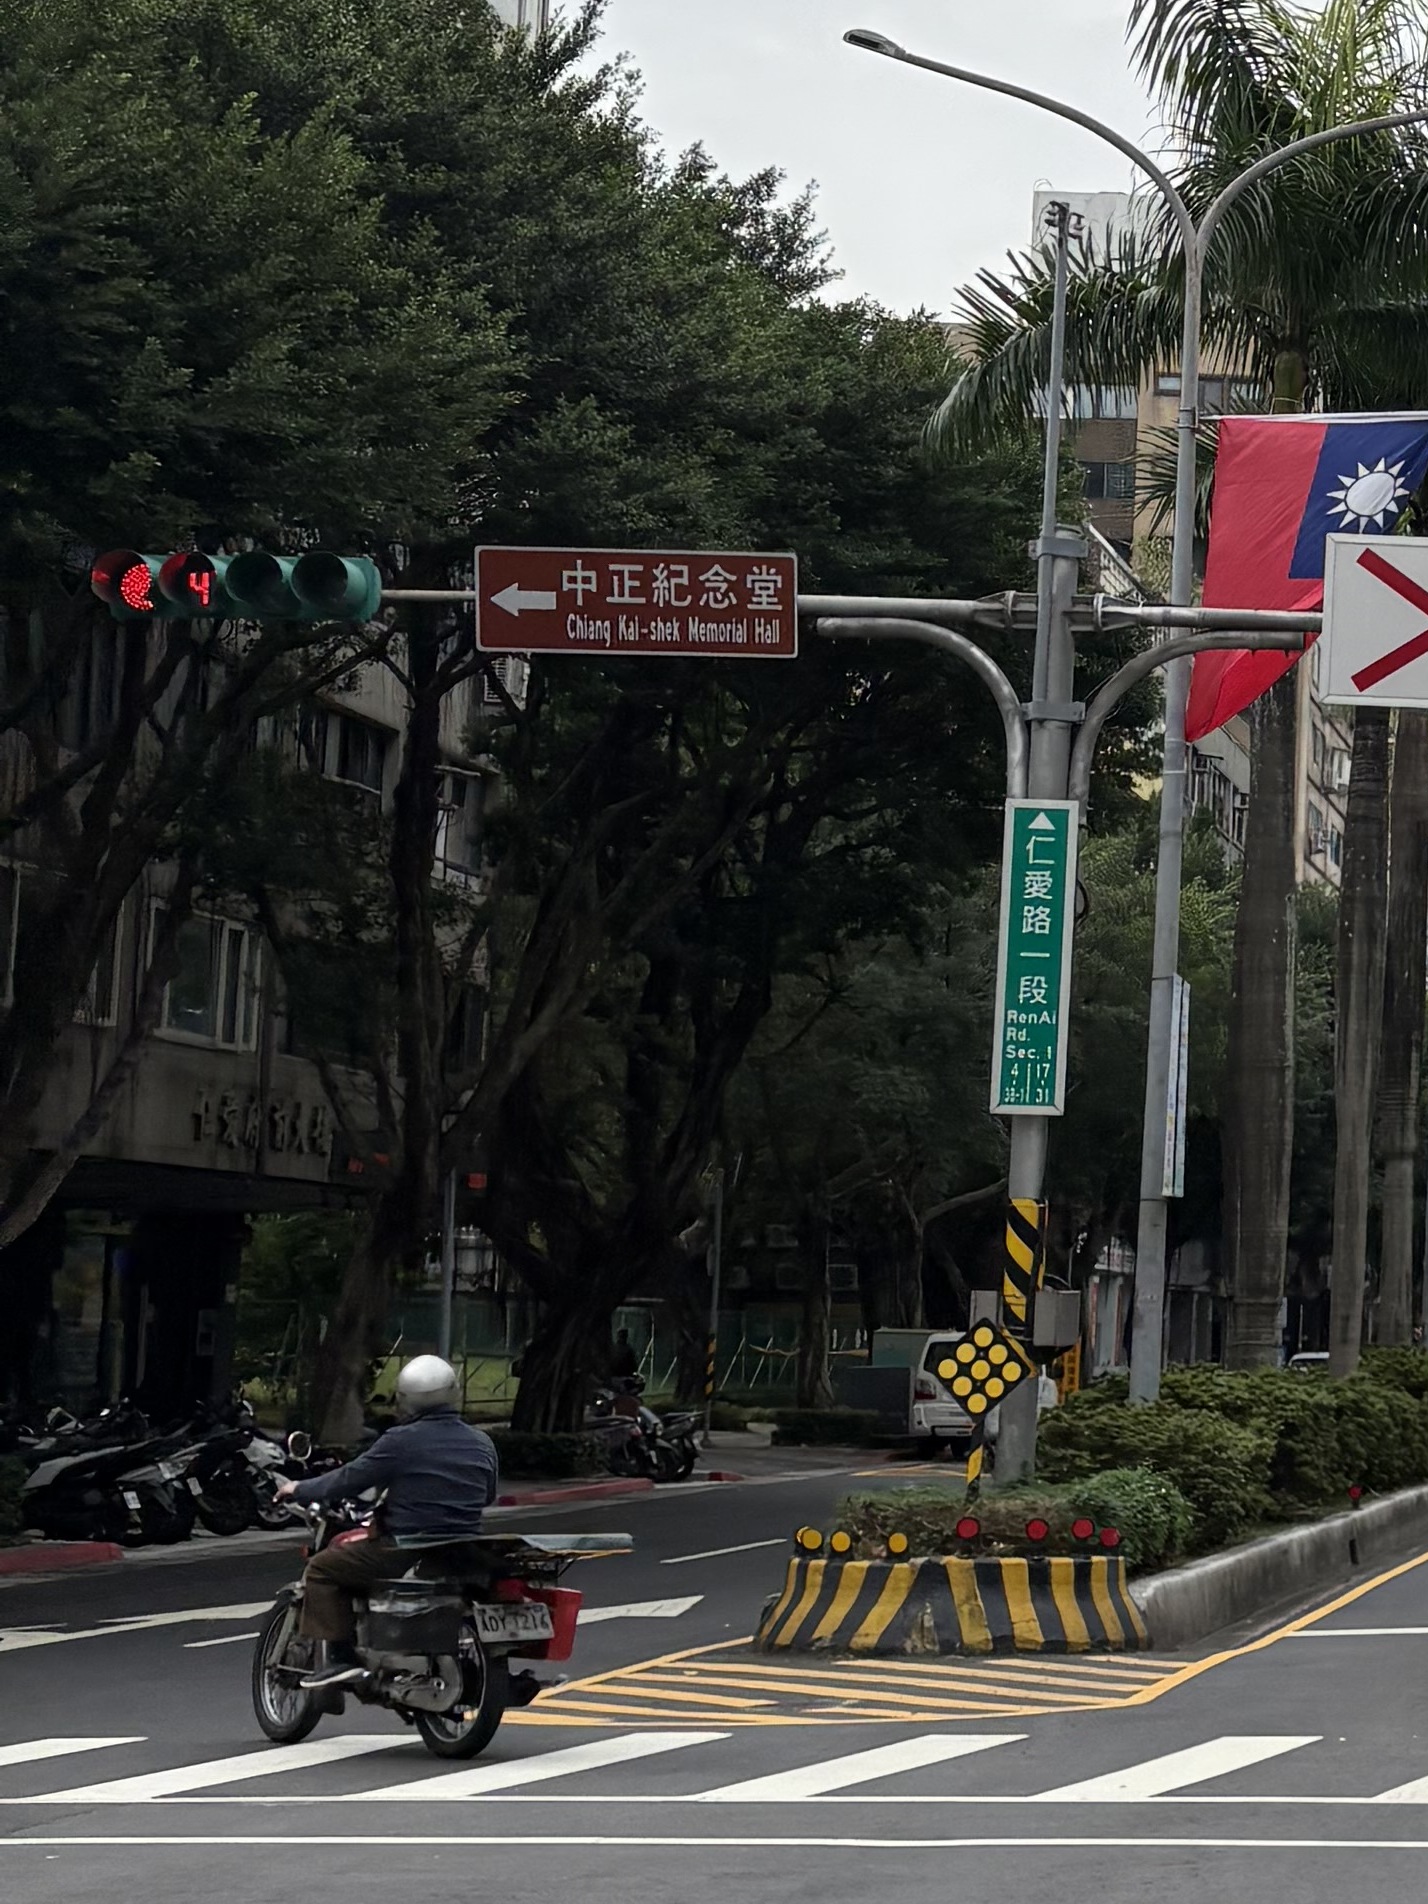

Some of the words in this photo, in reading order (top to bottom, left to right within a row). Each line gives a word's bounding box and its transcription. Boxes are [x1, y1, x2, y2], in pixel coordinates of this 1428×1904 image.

[561, 559, 783, 611] 中正紀念堂
[566, 613, 611, 647] Chiang
[618, 614, 681, 642] Kai-shek
[688, 617, 747, 644] Memorial
[754, 618, 781, 644] Hall
[1018, 835, 1055, 1005] 仁愛路一段
[1006, 1027, 1031, 1041] Rd.
[1005, 1044, 1040, 1059] Sec.
